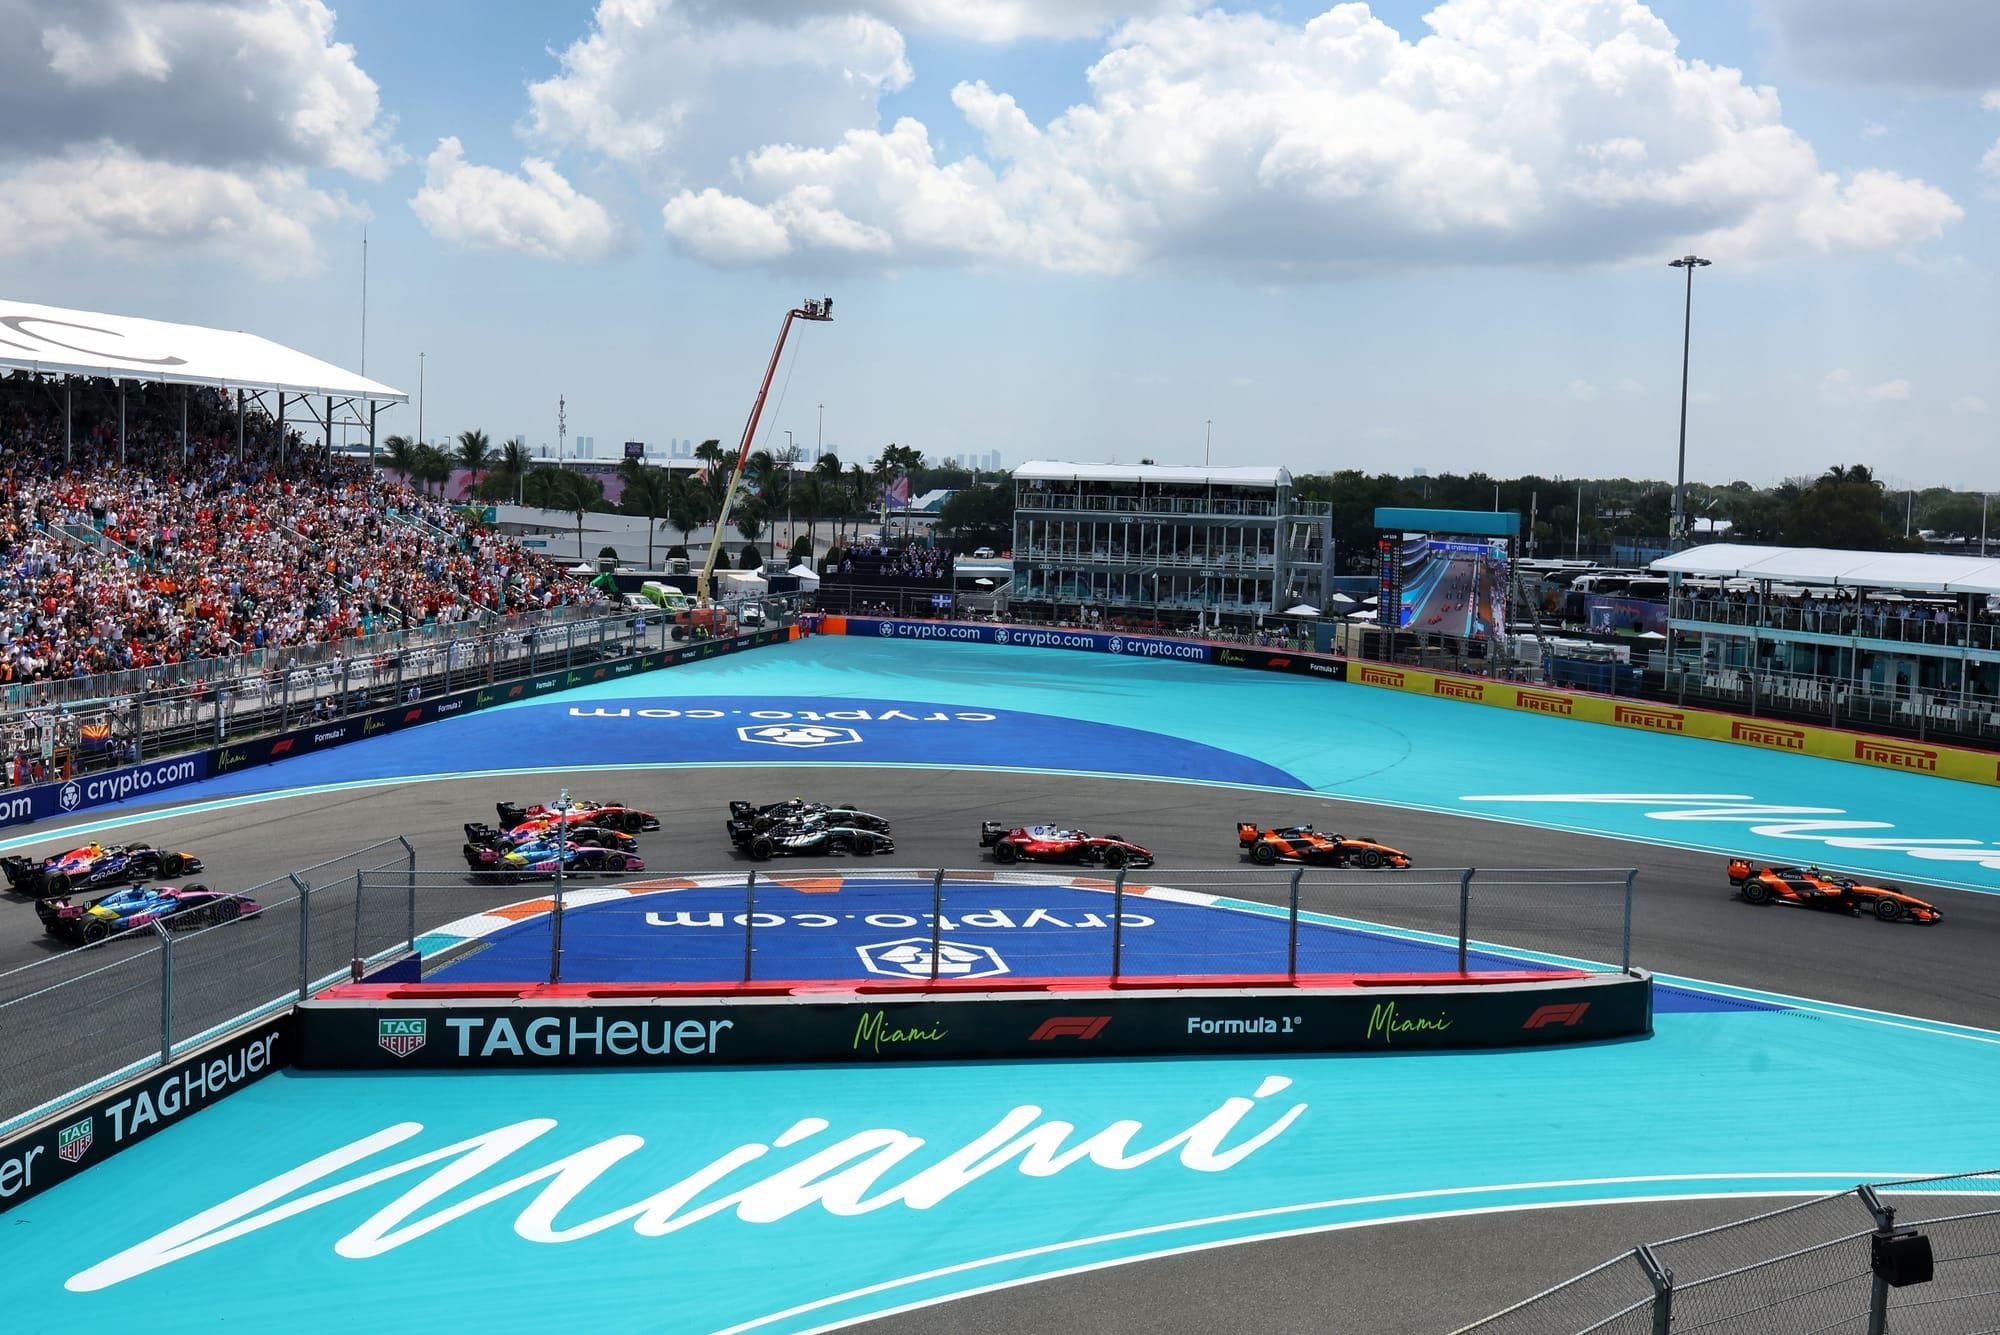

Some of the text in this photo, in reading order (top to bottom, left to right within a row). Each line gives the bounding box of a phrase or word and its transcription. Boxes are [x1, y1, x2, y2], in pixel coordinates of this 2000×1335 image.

[898, 624, 981, 640] crypto.com
[1013, 631, 1094, 649] crypto.com
[1127, 640, 1204, 659] crypto.com
[1310, 663, 1332, 673] Formula
[1361, 666, 1405, 688] PIRELLI
[1434, 678, 1484, 701] PIRELLI
[438, 701, 457, 713] Formula
[1516, 690, 1573, 715] PIRELLI
[363, 715, 386, 735] Miami
[569, 707, 997, 722] crypto.com
[1615, 705, 1685, 731] PIRELLI
[315, 729, 340, 744] Formula
[1731, 721, 1805, 750] PIRELLI
[218, 750, 247, 770] Miami
[1855, 739, 1938, 772] PIRELLI
[87, 760, 195, 800] crypto.com
[90, 863, 128, 882] ORACLE
[646, 908, 1155, 931] crypto.com
[384, 1020, 421, 1034] TAG
[853, 1010, 949, 1054] Miami
[1187, 1016, 1277, 1034] Formula
[1367, 1001, 1454, 1043] Miami
[380, 1036, 425, 1051] HEUER
[446, 1017, 734, 1057] TAGHeuer
[105, 1031, 279, 1142] TAGHeuer
[60, 1120, 91, 1146] TAG
[58, 1134, 93, 1162] HEUER
[64, 1075, 1310, 1293] Miami
